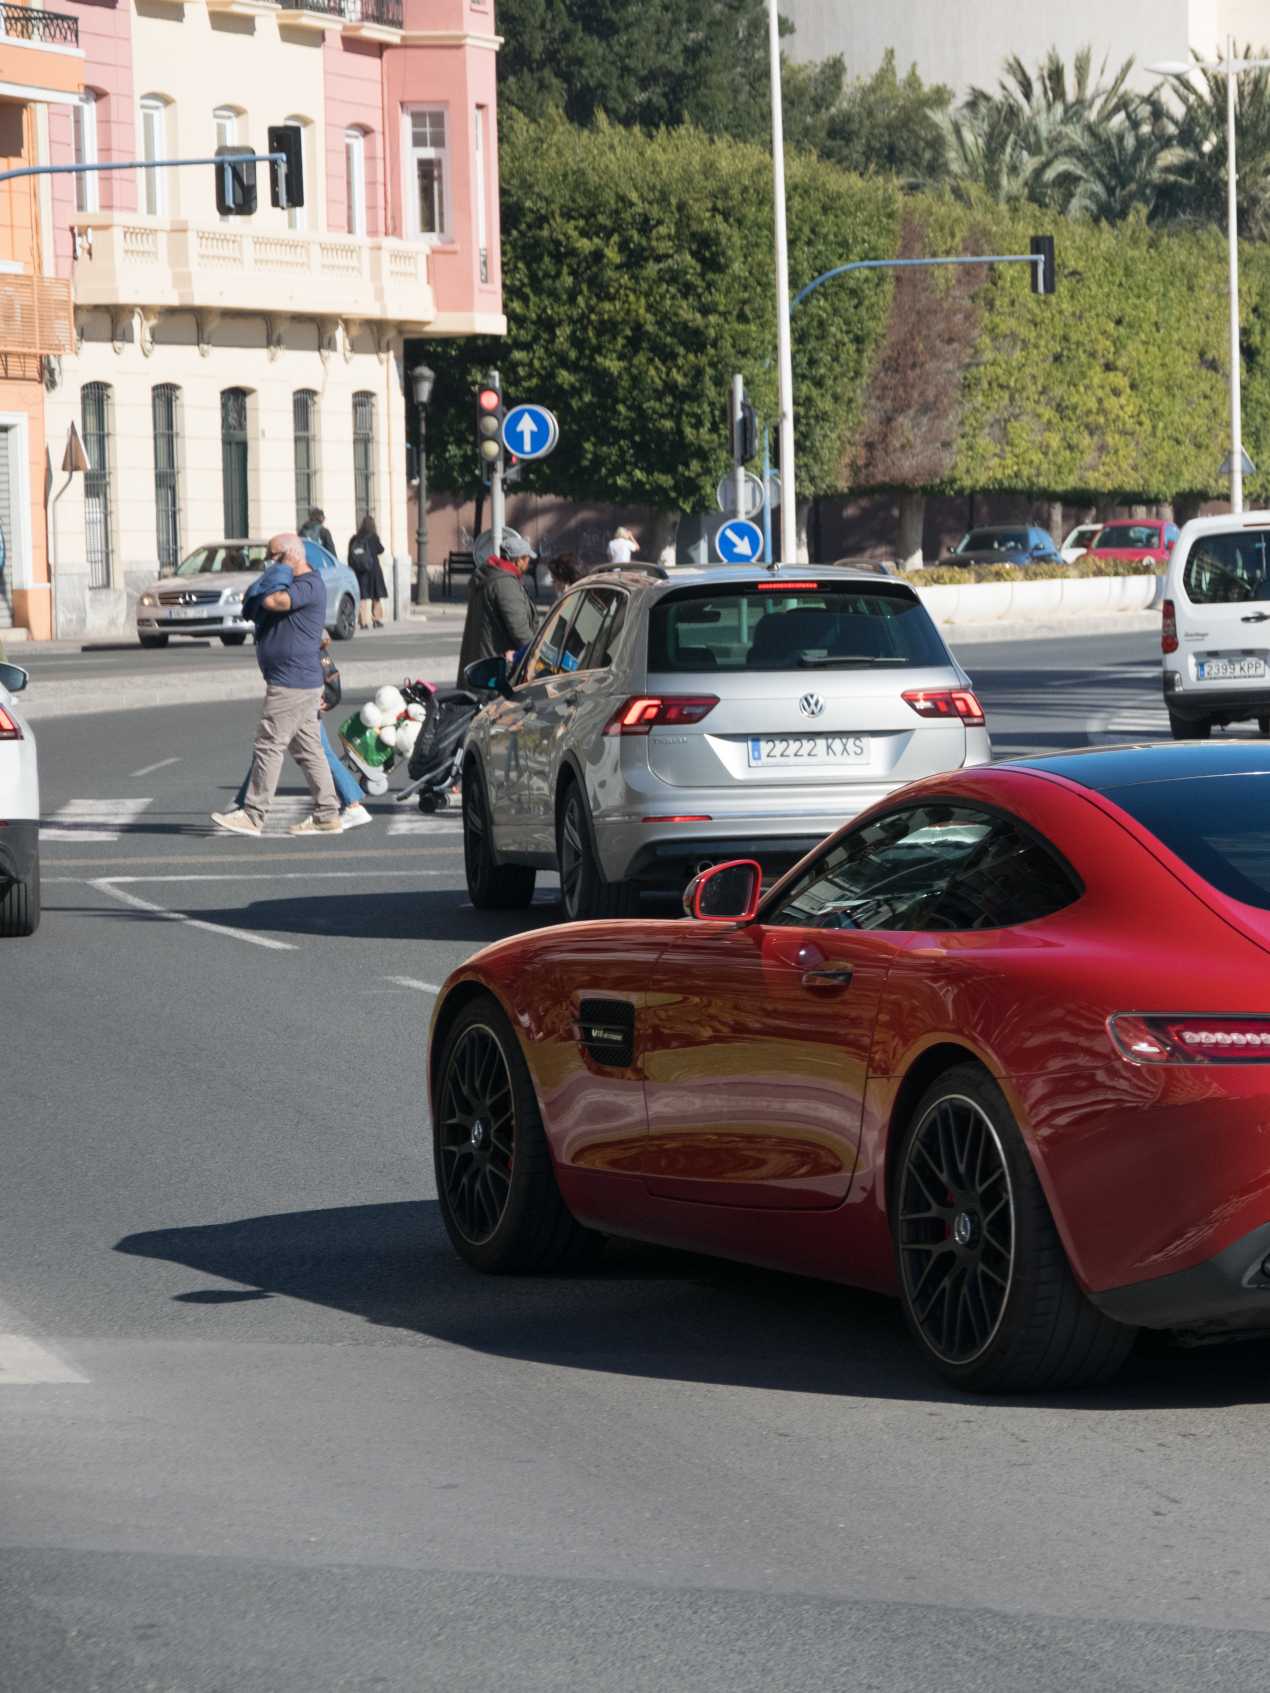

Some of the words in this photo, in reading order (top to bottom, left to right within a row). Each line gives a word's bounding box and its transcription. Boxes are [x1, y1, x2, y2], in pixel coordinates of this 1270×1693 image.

[1207, 663, 1235, 676] 2399
[1240, 660, 1262, 674] KPP
[766, 738, 817, 758] 2222
[825, 737, 864, 757] KXS
